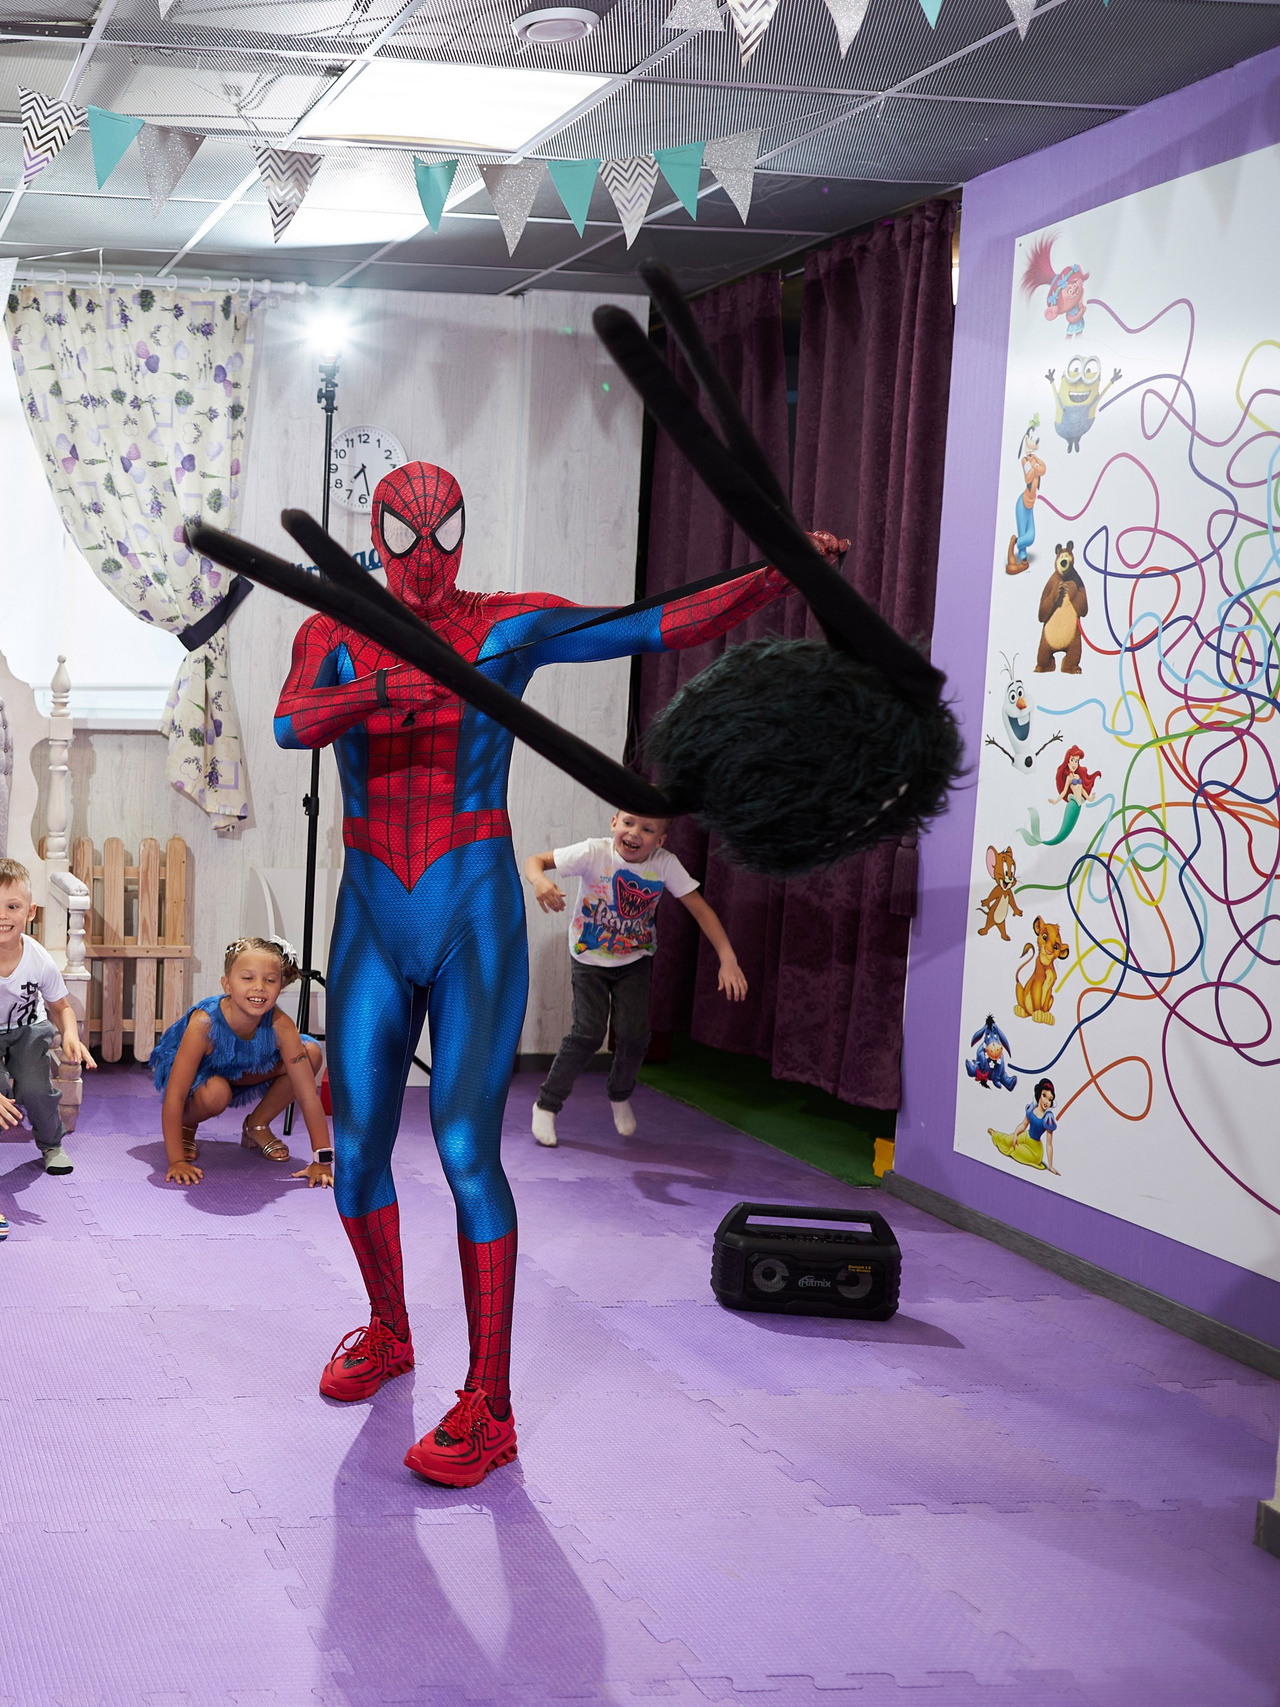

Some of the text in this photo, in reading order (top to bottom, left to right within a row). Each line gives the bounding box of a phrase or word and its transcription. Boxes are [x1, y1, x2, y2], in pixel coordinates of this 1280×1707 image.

[345, 438, 354, 448] 11
[358, 433, 370, 443] 12
[376, 438, 381, 448] 1
[334, 449, 346, 459] 10
[384, 449, 392, 459] 2
[330, 463, 338, 473] 9
[334, 479, 343, 488] 8
[345, 489, 353, 499] 7
[358, 494, 368, 504] 6
[798, 1275, 831, 1287] Ritmix
